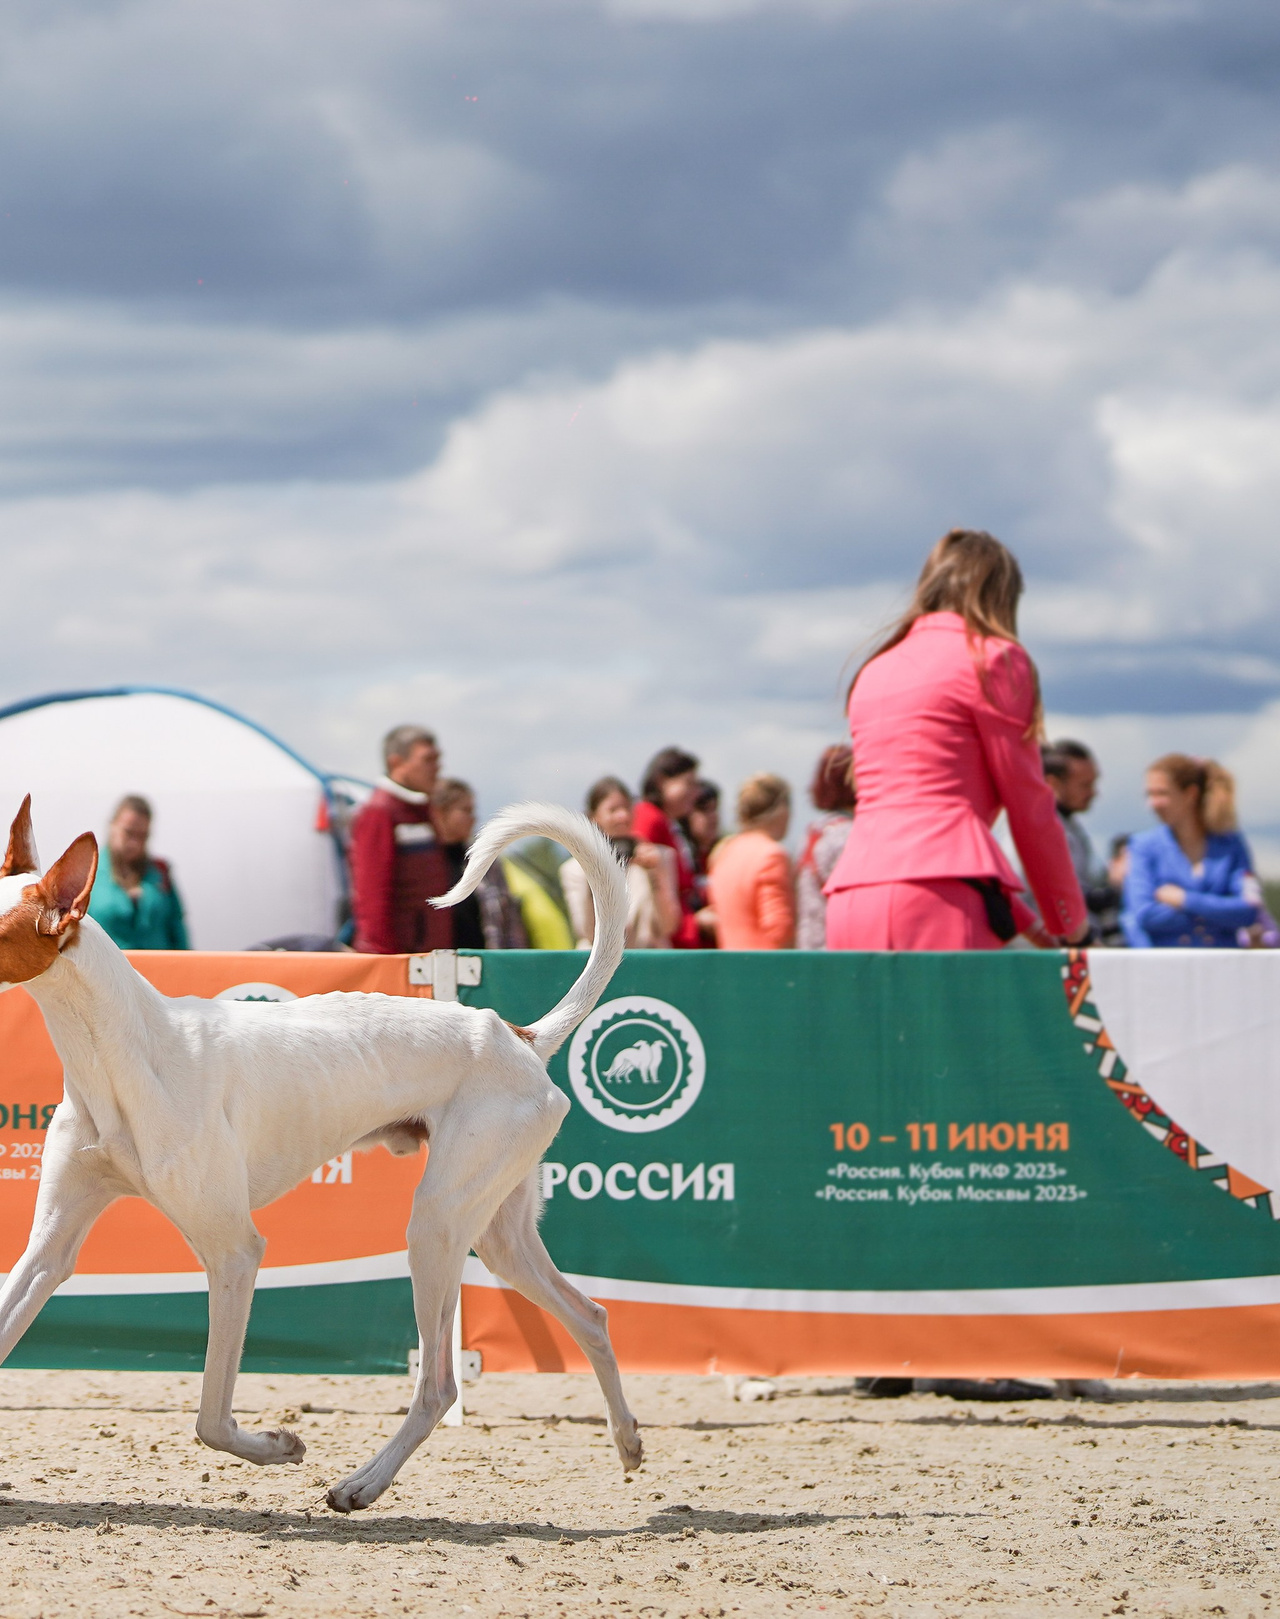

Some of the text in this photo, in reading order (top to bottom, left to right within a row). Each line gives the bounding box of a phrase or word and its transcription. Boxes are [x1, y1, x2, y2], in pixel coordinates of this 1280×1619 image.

[829, 1122, 870, 1151] 10
[906, 1123, 938, 1151] 11
[948, 1122, 1070, 1151] ИЮНЯ
[10, 1142, 45, 1158] 202
[542, 1162, 735, 1200] РОССИЯ
[909, 1162, 964, 1183] Кубок
[969, 1163, 1010, 1179] РКФ
[897, 1185, 952, 1205] Кубок
[956, 1186, 1030, 1201] Москвы
